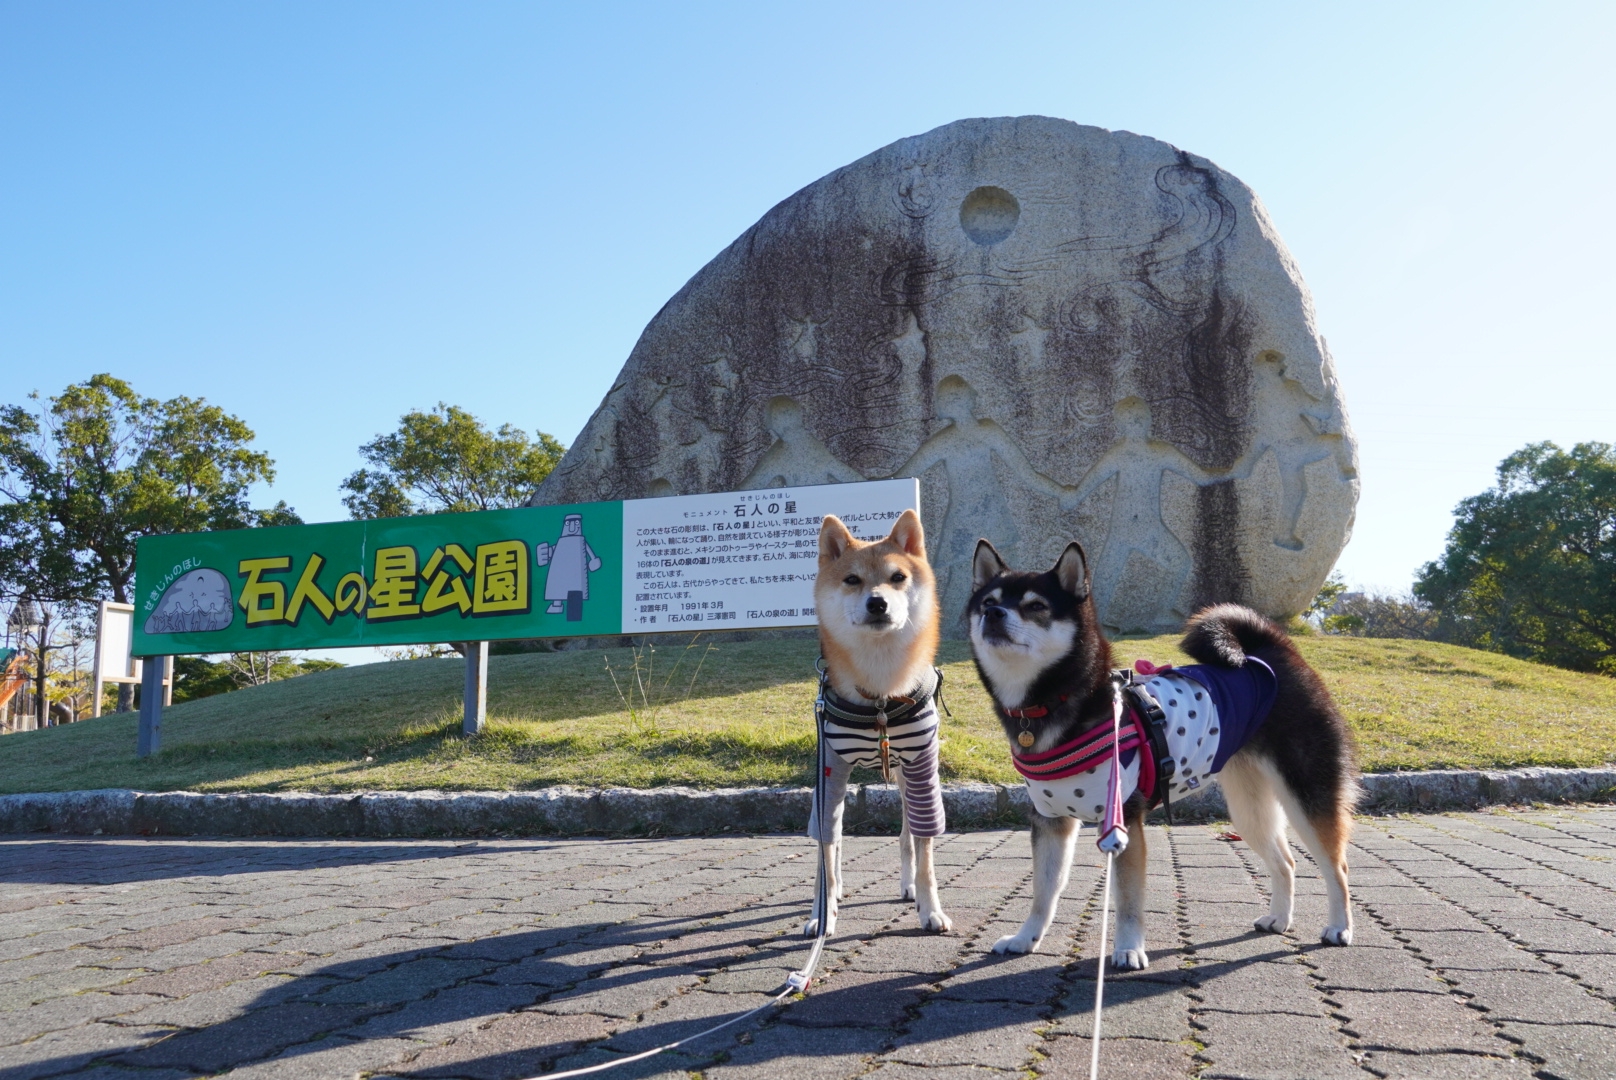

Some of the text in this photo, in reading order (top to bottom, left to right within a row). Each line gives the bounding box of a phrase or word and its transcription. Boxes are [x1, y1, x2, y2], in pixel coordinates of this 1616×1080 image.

[740, 493, 791, 502] せきじんのほし
[683, 500, 797, 519] モニュメント 石人の星
[636, 569, 684, 580] 表現しています。
[144, 556, 202, 611] せきじんのほし
[238, 539, 530, 626] 石人の星公園
[635, 591, 692, 602] 配置されています。
